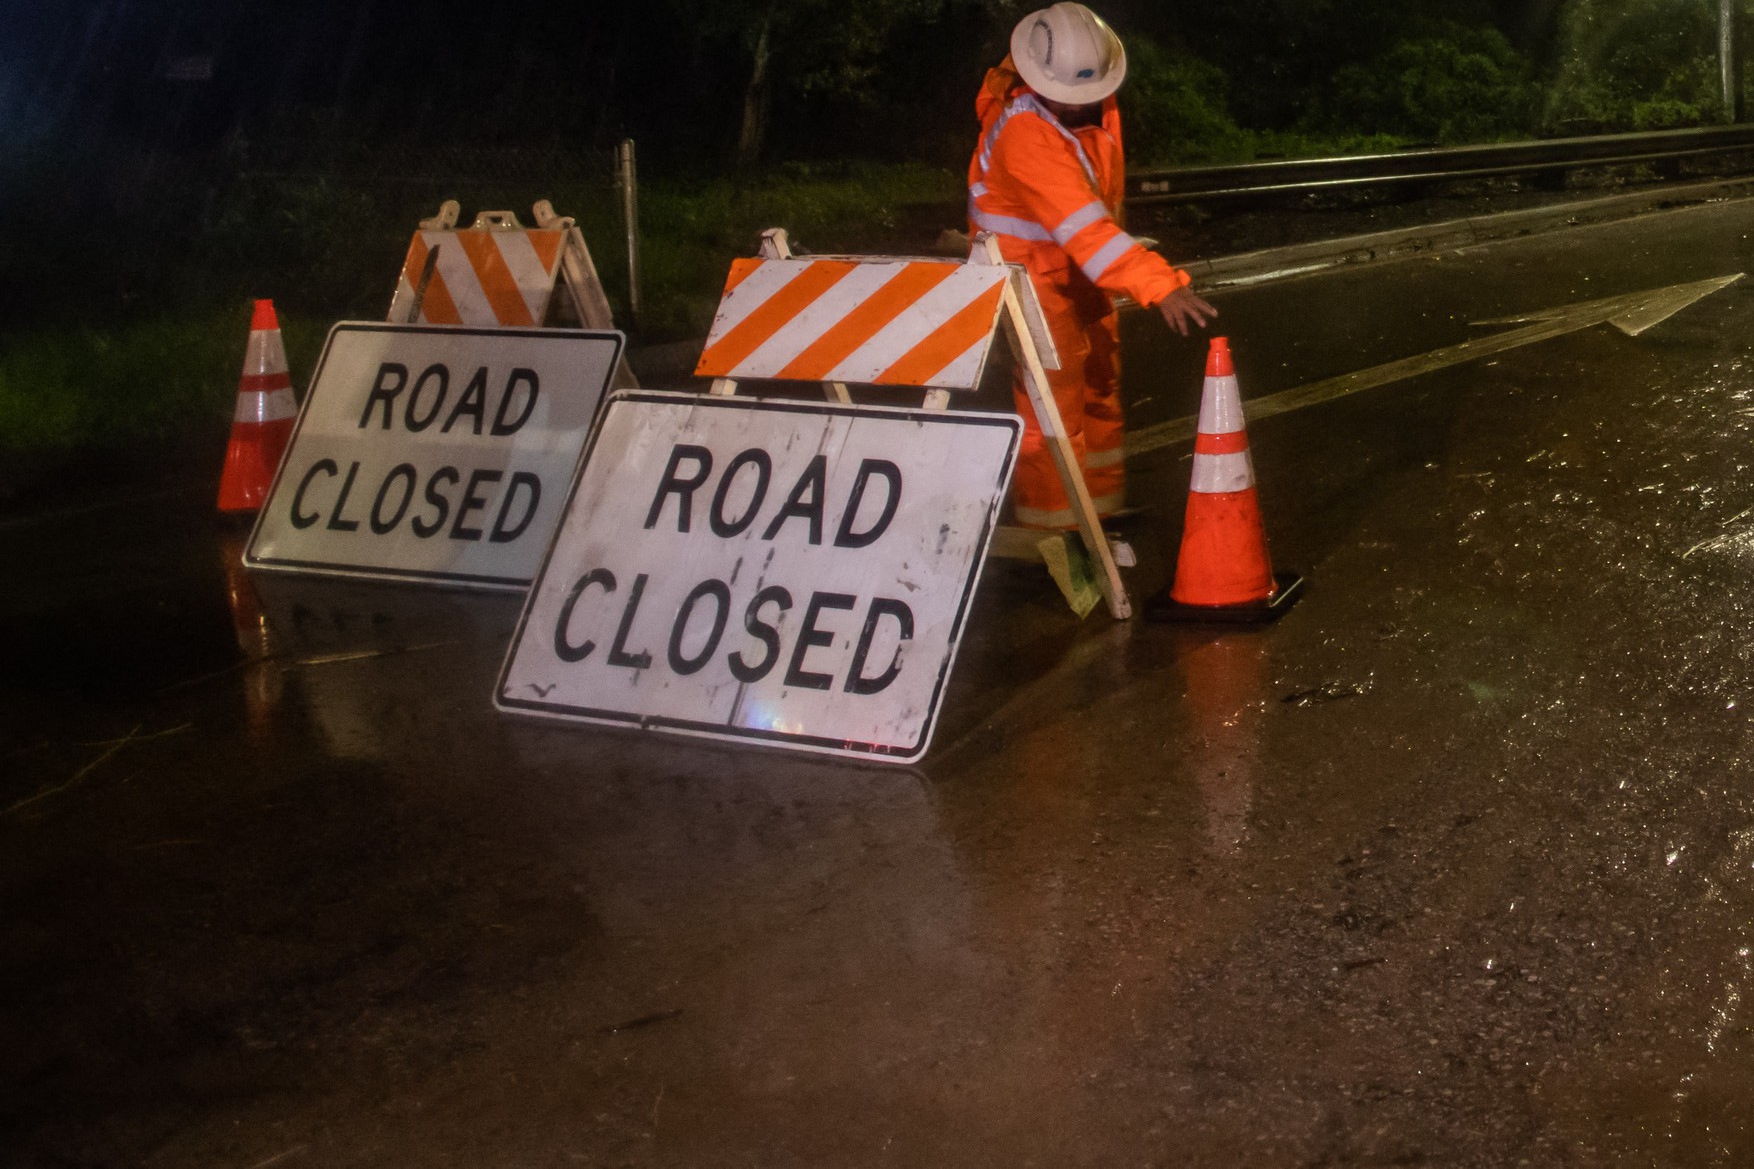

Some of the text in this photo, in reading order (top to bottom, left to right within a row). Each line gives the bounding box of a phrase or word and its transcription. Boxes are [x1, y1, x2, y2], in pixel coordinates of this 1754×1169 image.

[358, 362, 540, 437] ROAD
[290, 458, 542, 544] CLOSED
[643, 443, 903, 549] ROAD
[553, 567, 915, 696] CLOSED
